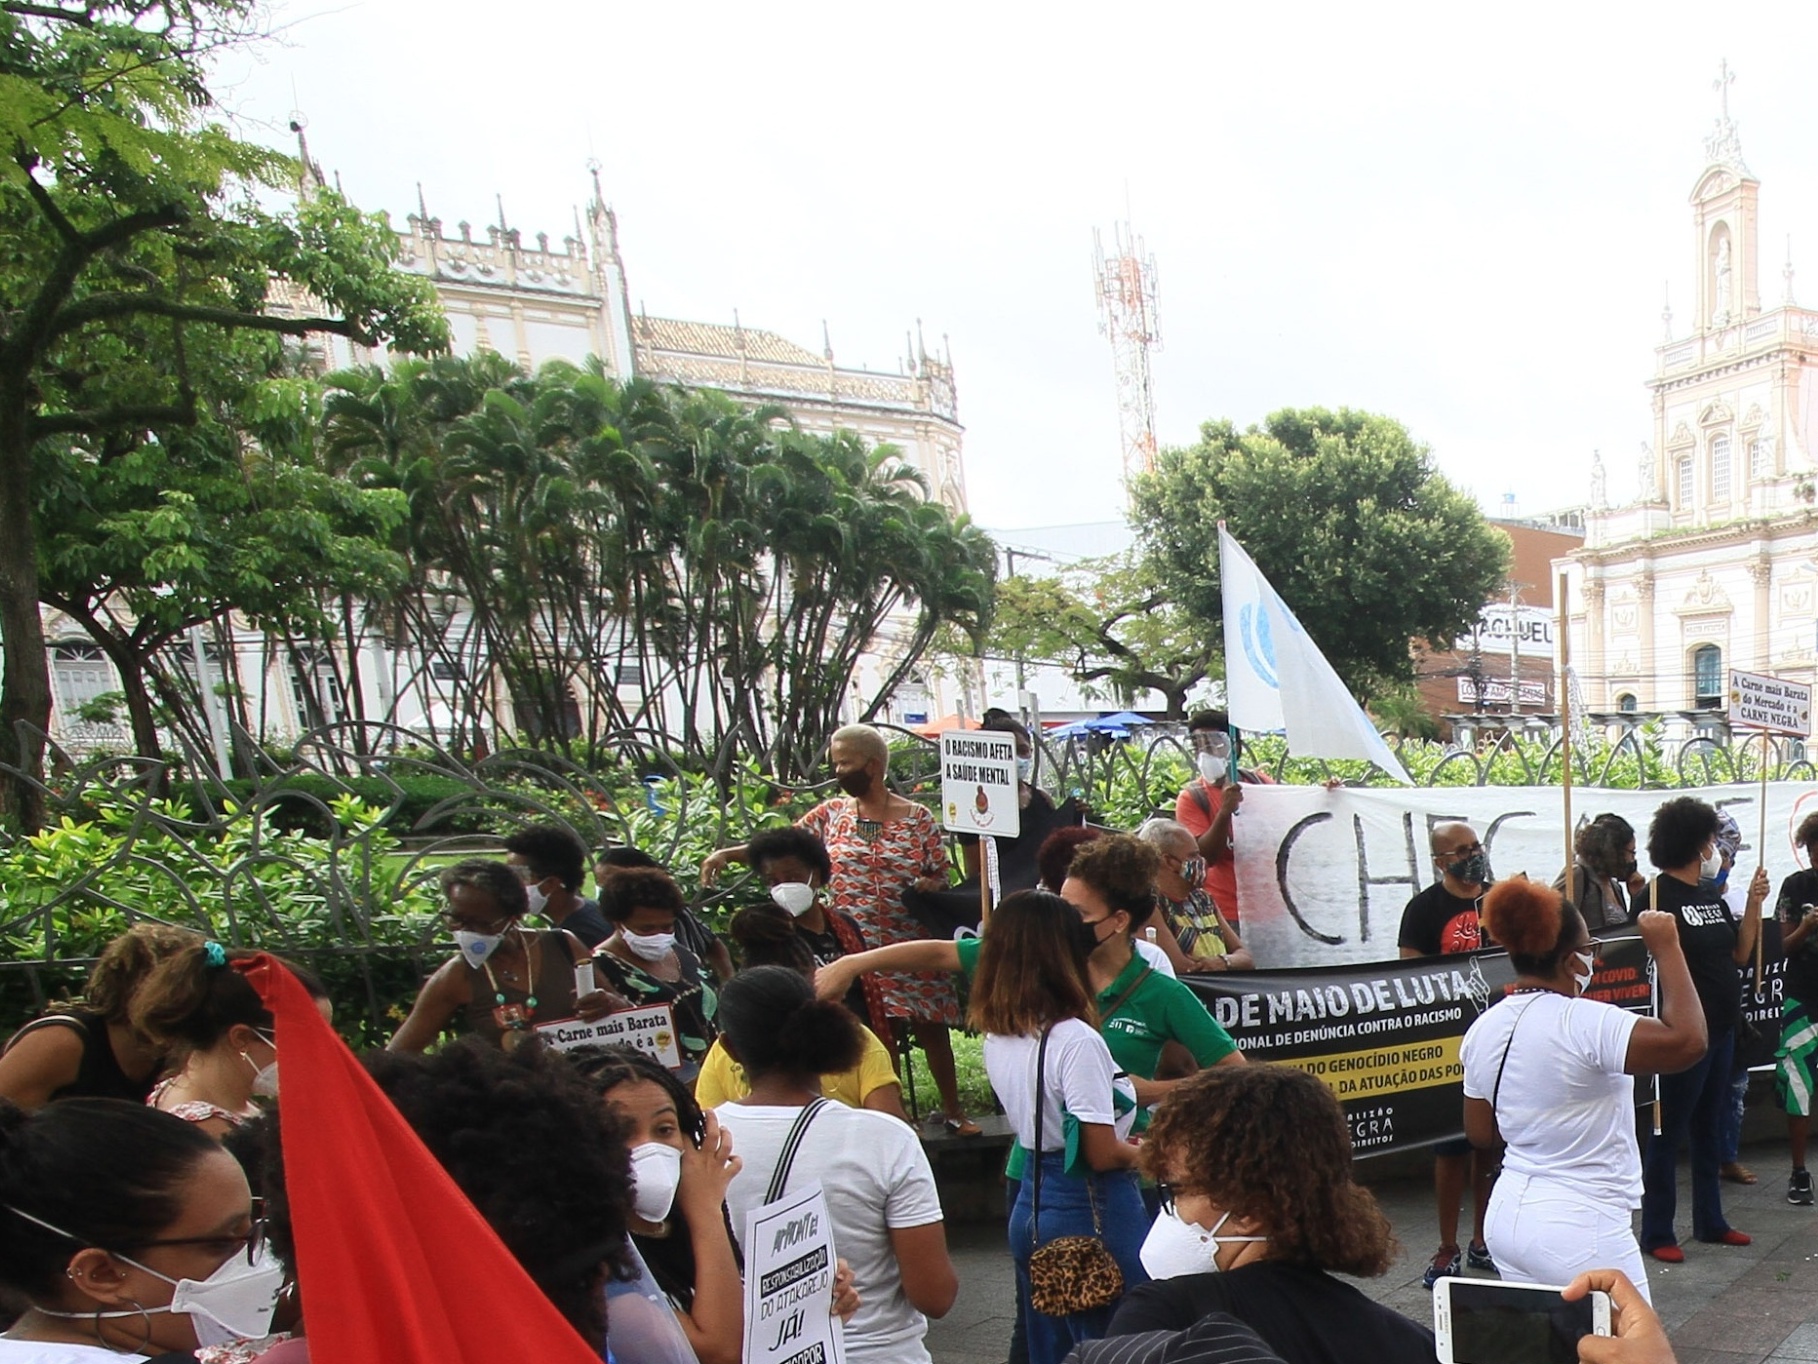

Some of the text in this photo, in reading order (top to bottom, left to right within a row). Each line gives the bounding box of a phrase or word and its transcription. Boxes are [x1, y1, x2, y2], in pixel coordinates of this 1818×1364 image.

[1732, 675, 1808, 701] A Carne mais Barata
[1743, 693, 1752, 704] do
[1754, 695, 1784, 711] Mercado
[1793, 705, 1798, 714] a
[1740, 707, 1798, 728] CARNE NEGRA
[945, 739, 1014, 761] O RACISMO AFETA
[945, 761, 1010, 785] A SAÚDE MENTAL
[1215, 969, 1473, 1030] DE MAIO DE LUTA
[556, 1027, 594, 1044] Carne
[596, 1018, 625, 1038] mais
[627, 1013, 668, 1032] Barata
[646, 1035, 654, 1047] a
[1233, 1007, 1462, 1051] IONAL DE DENÚNCIA CONTRA O RACISMO
[1306, 1045, 1443, 1076] DO GENOCÍDIO NEGRO
[1338, 1064, 1443, 1095] DA ATUAÇÃO DAS
[760, 1275, 829, 1321] DO ATAKAREJO
[768, 1308, 805, 1352] JÁ!
